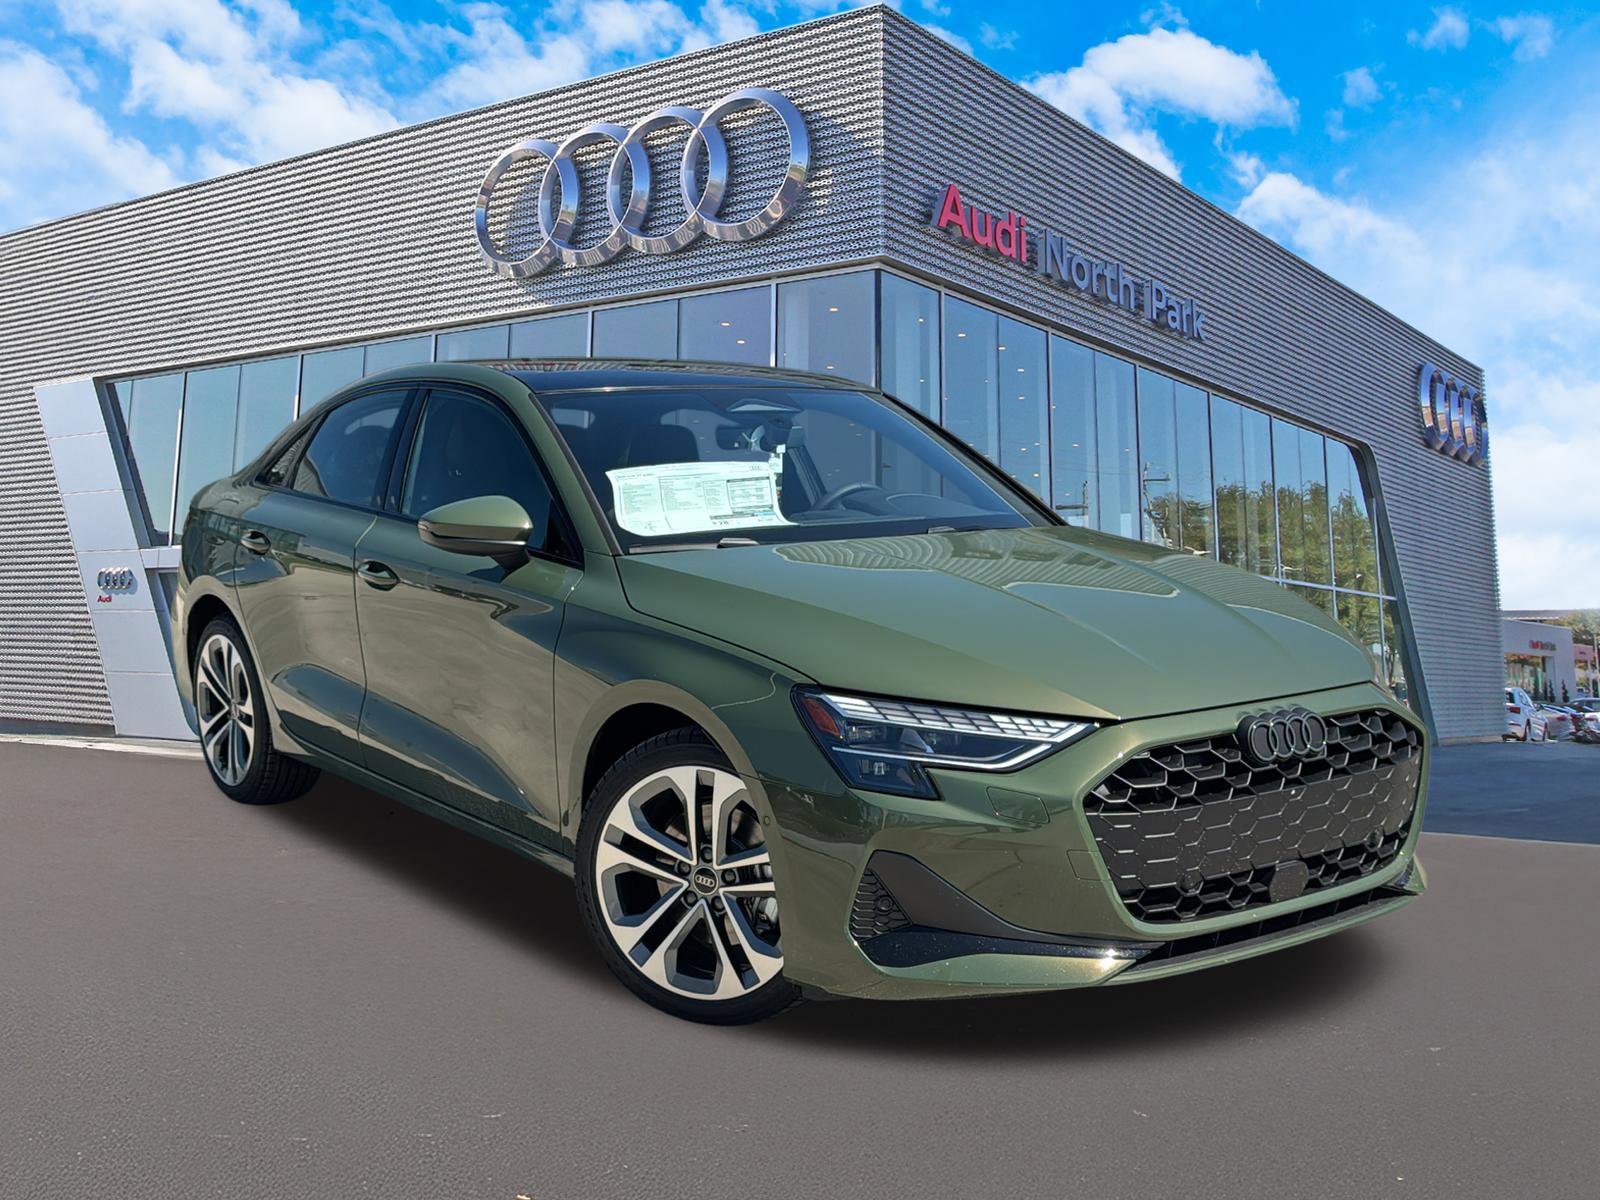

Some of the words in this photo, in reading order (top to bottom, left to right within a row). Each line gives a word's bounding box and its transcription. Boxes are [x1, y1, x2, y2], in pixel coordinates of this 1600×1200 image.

[935, 184, 1028, 263] Audi
[1041, 228, 1137, 310] North
[1147, 279, 1206, 341] Park
